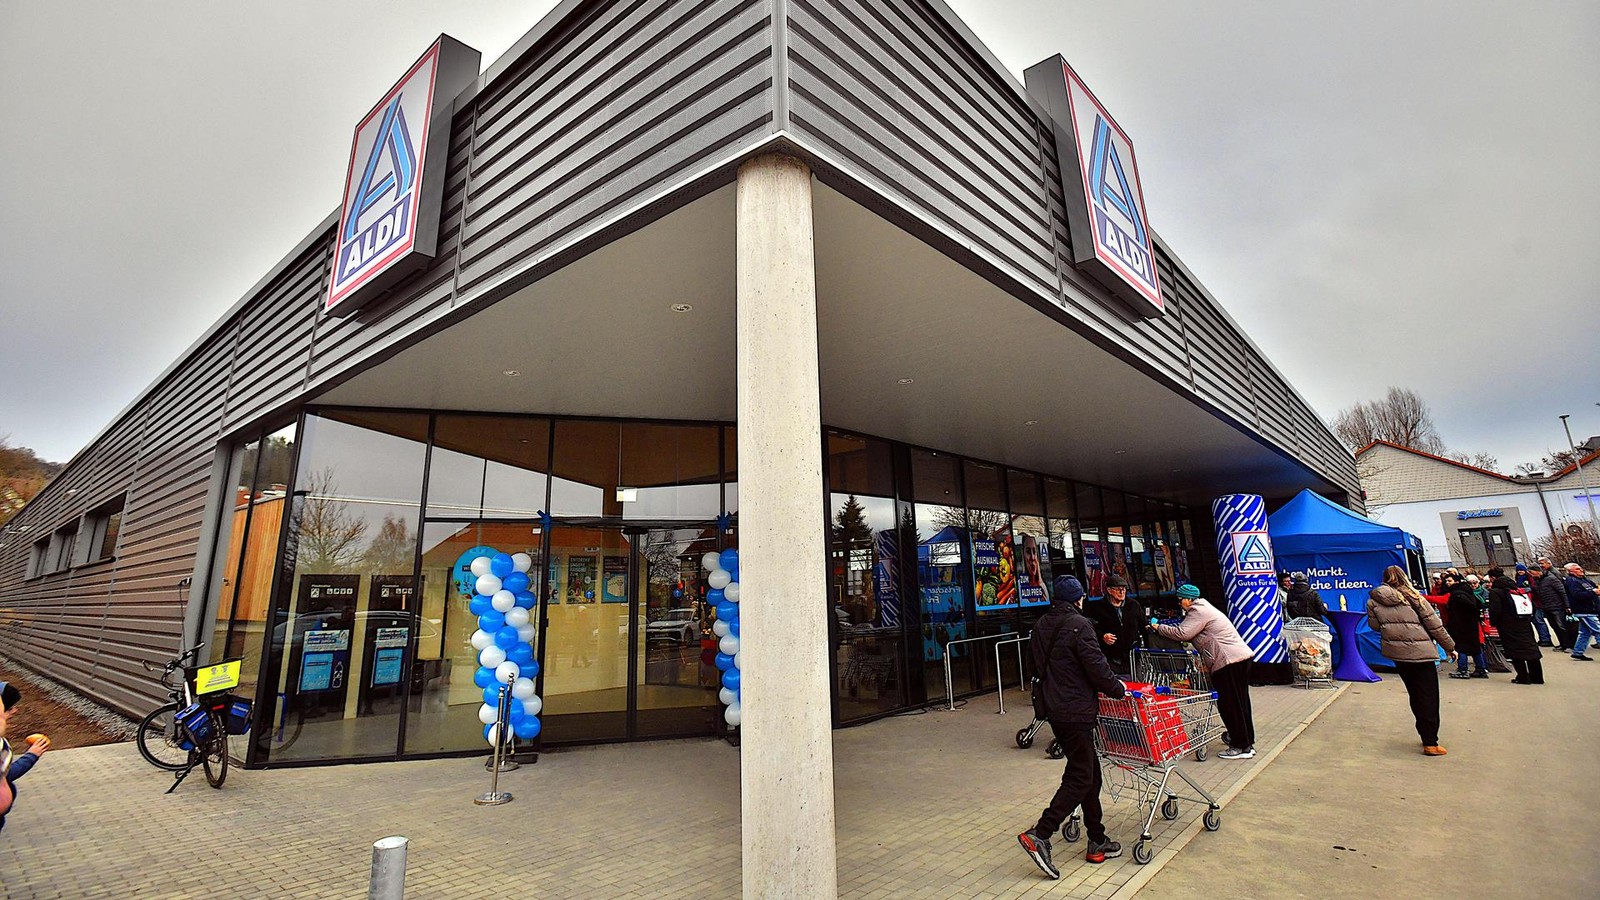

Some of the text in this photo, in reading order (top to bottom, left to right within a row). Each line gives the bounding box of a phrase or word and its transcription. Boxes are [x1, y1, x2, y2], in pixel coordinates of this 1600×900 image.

[342, 203, 405, 278] ALDI
[1105, 218, 1151, 282] ALDI
[975, 541, 995, 551] FRISCHE
[976, 556, 999, 565] AUSWAHL
[1243, 562, 1270, 570] ALDI
[1307, 566, 1348, 578] Markt.
[1019, 575, 1029, 584] ZUM
[1237, 579, 1258, 587] Gutes
[1258, 578, 1268, 586] für
[1335, 578, 1373, 589] Ideen.
